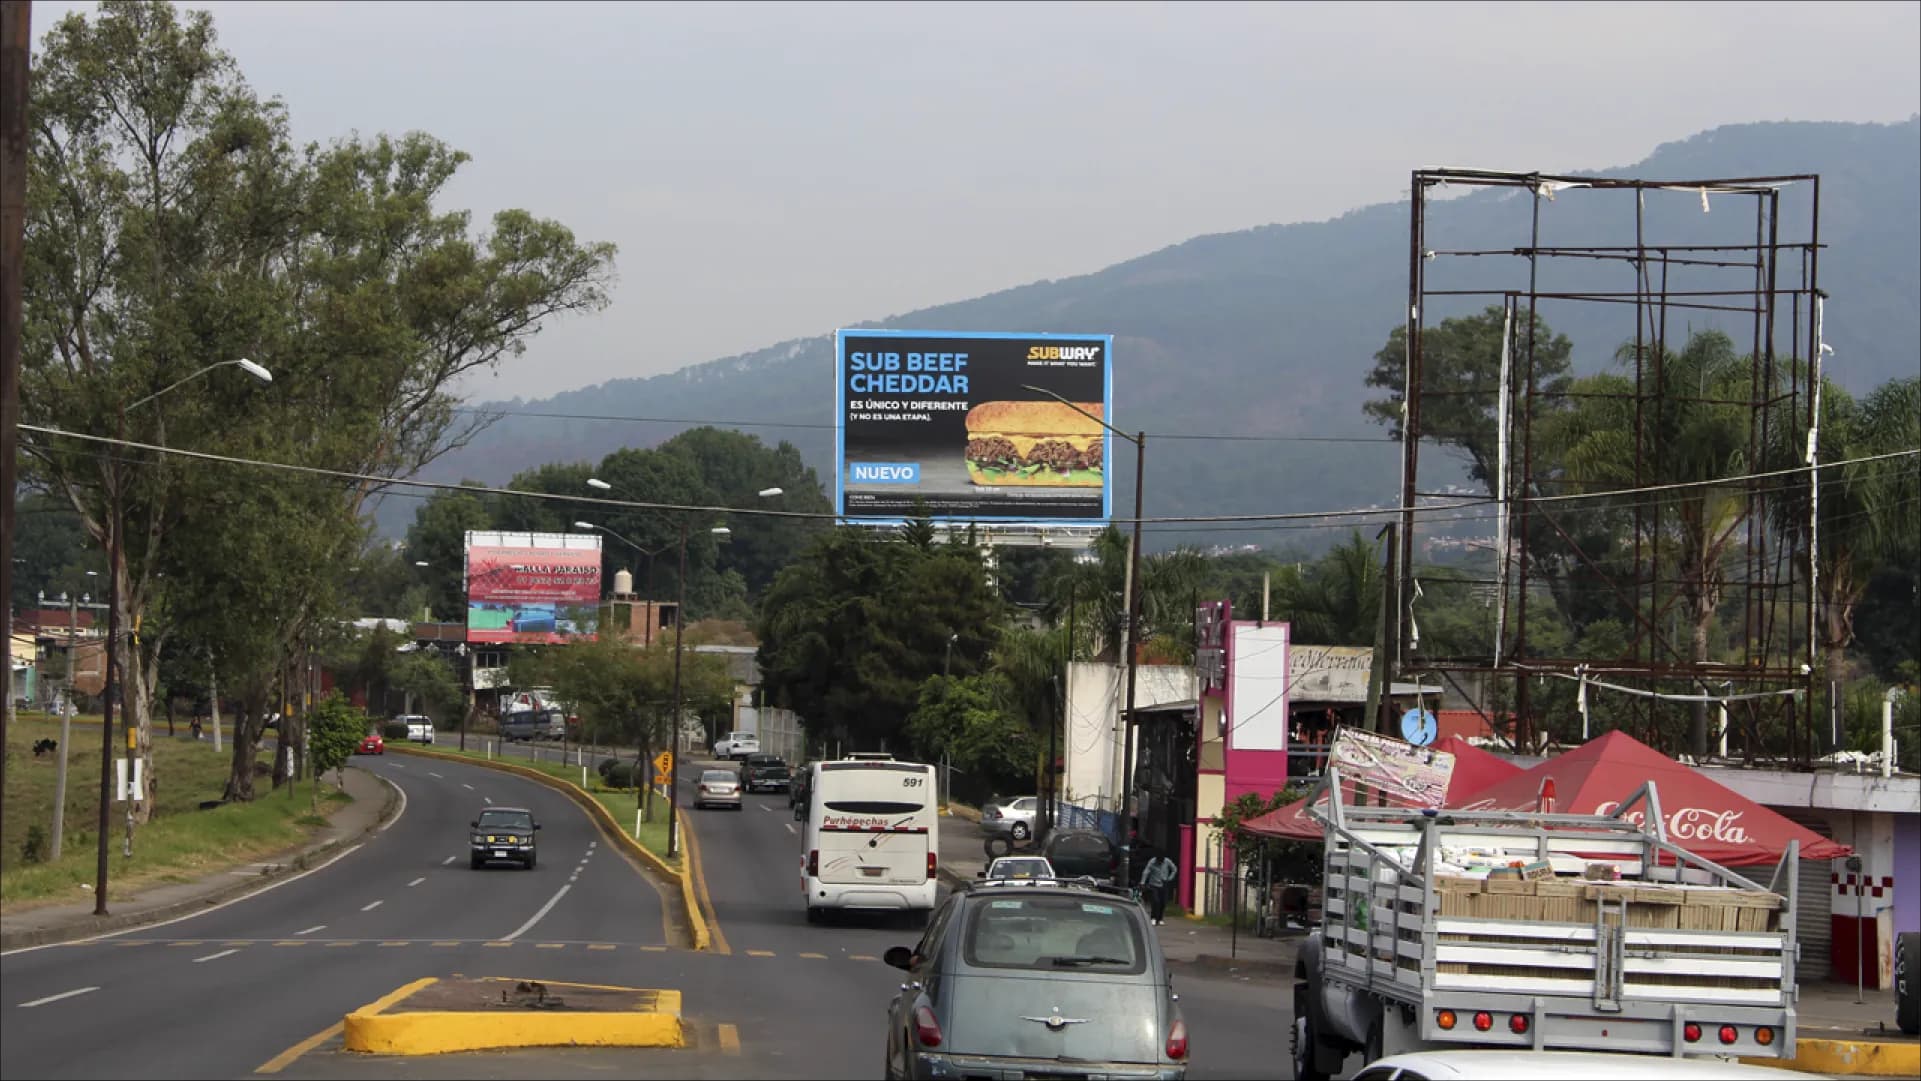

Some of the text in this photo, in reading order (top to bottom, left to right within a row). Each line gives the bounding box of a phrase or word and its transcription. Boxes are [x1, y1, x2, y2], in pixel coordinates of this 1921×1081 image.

[1027, 346, 1100, 360] SUBWAY
[850, 351, 969, 372] SUB BEEF
[850, 373, 969, 394] CHEDDAR
[850, 398, 969, 411] ES ÚNICO Y DIFERENTE
[859, 413, 872, 421] NO
[873, 413, 883, 421] ES
[884, 413, 901, 421] UNA
[855, 465, 914, 480] NUEVO
[903, 777, 923, 787] 591
